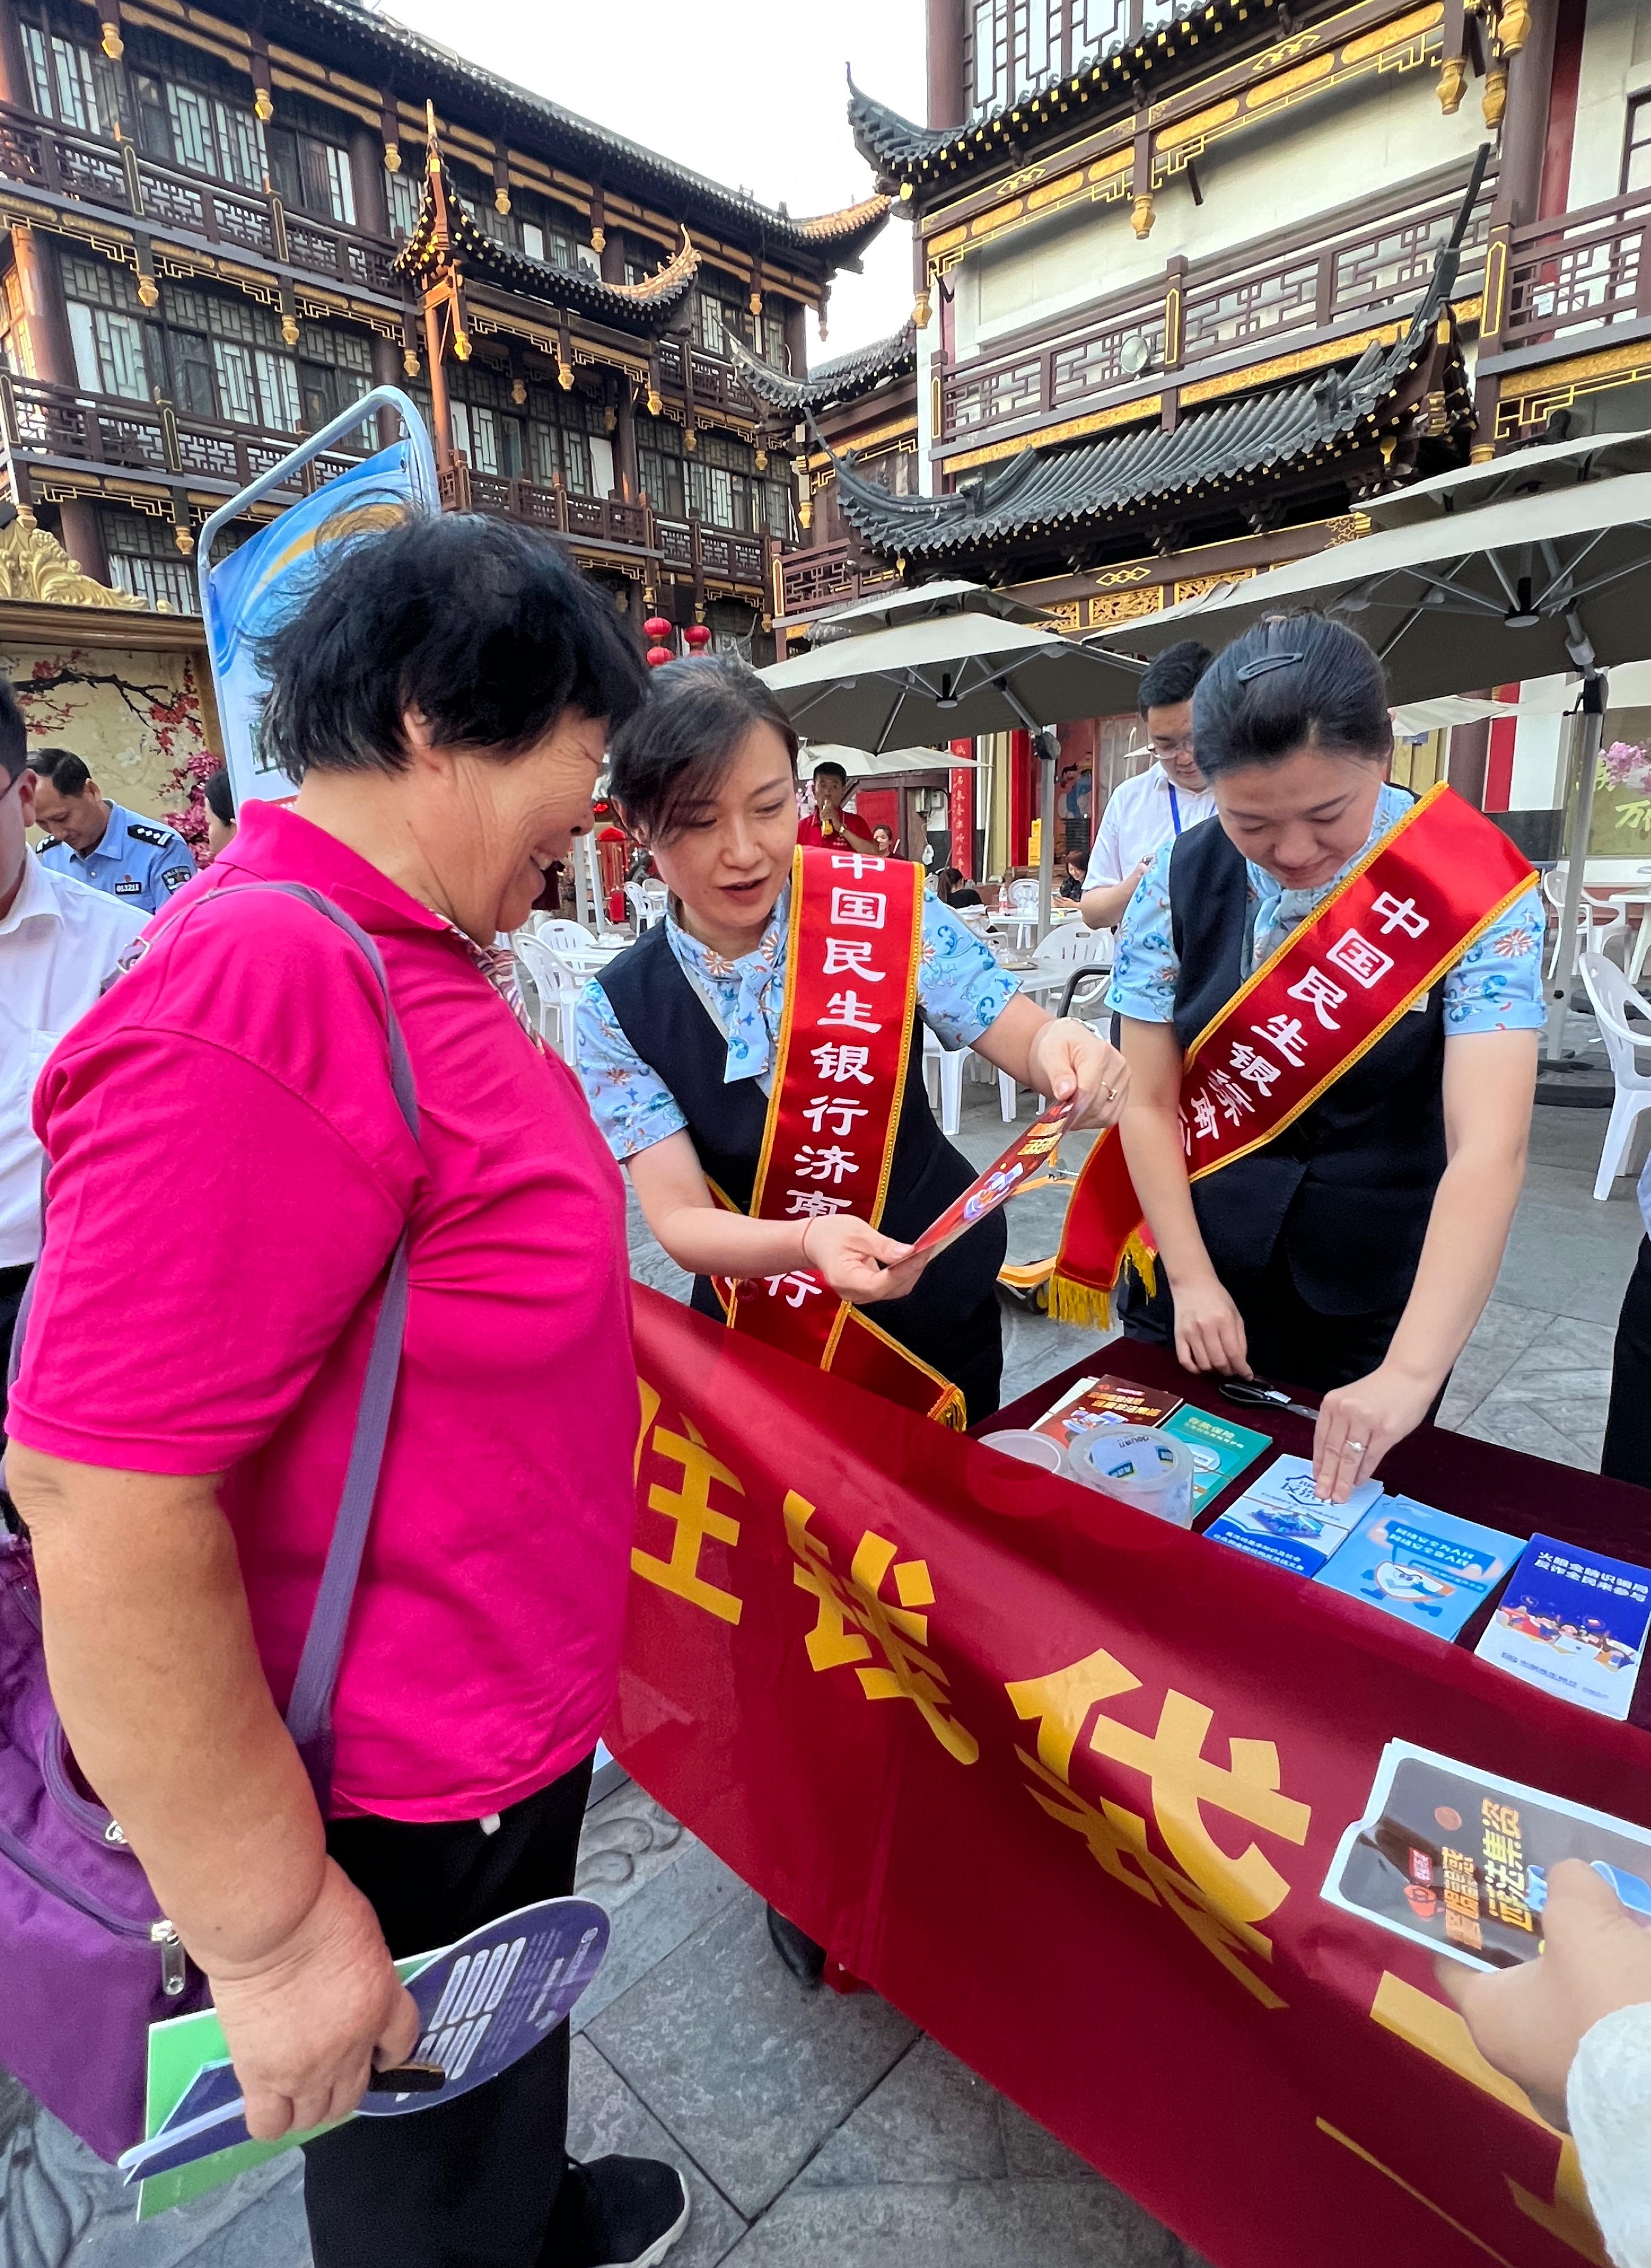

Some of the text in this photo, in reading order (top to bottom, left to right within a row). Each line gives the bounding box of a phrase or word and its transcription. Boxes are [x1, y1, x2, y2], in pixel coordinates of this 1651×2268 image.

[764, 853, 886, 1308] 中国民生银行济南行
[1538, 1551, 1649, 1594] 火眼金睛识骗局
